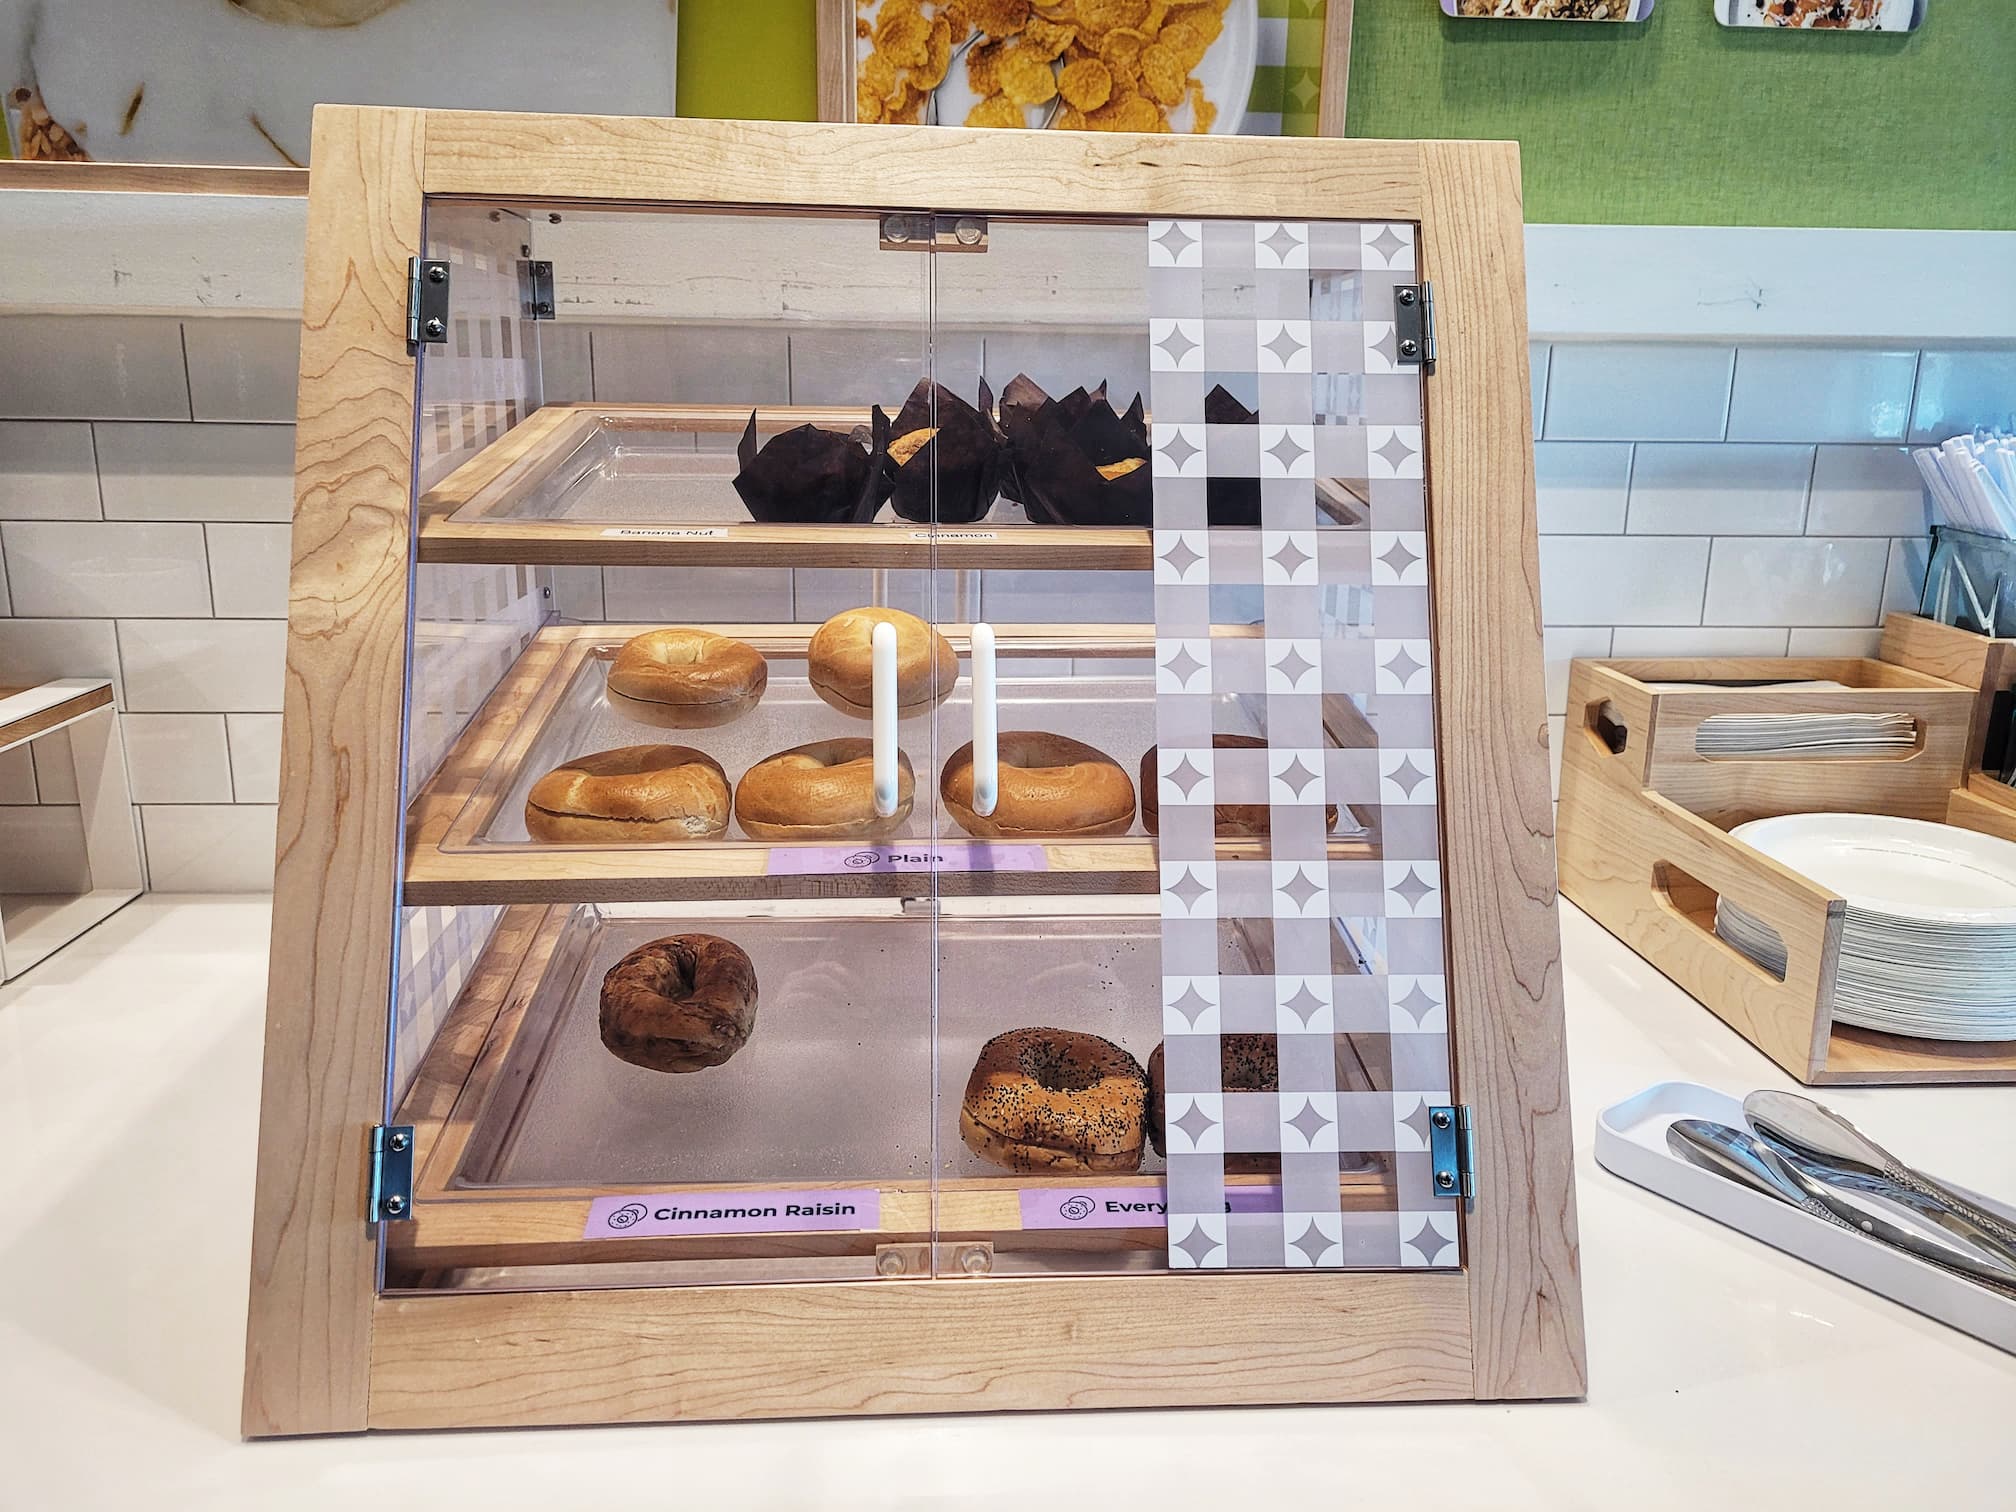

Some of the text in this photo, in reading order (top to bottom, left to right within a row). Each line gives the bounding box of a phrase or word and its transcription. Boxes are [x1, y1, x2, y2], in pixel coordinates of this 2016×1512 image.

[887, 854, 944, 863] Plain
[653, 1202, 856, 1220] Cinnamon Raisin
